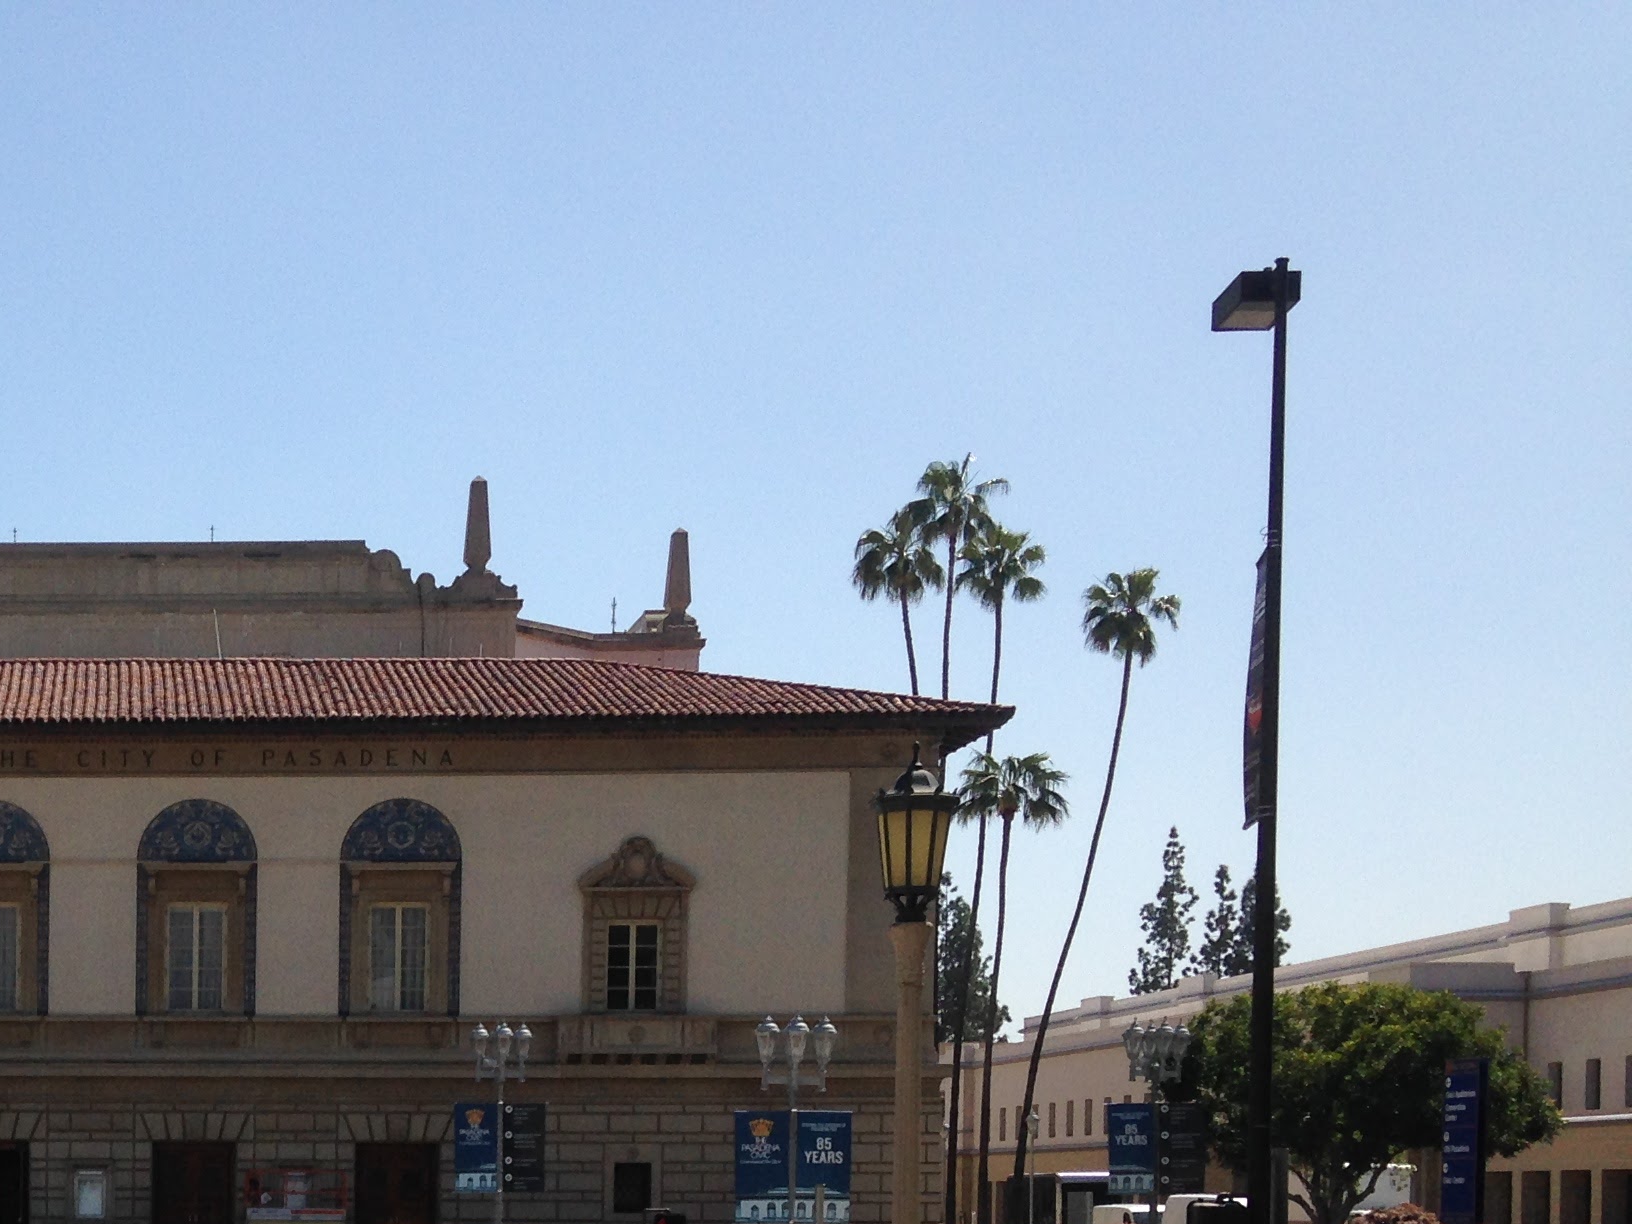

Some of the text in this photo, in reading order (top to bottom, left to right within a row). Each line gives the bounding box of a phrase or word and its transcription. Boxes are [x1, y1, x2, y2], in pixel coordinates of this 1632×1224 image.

[76, 749, 156, 768] CITY
[190, 749, 225, 768] OF
[261, 749, 454, 767] PASADENA
[816, 1137, 833, 1150] 85
[1114, 1134, 1148, 1146] YEARS
[804, 1150, 844, 1164] YEARS
